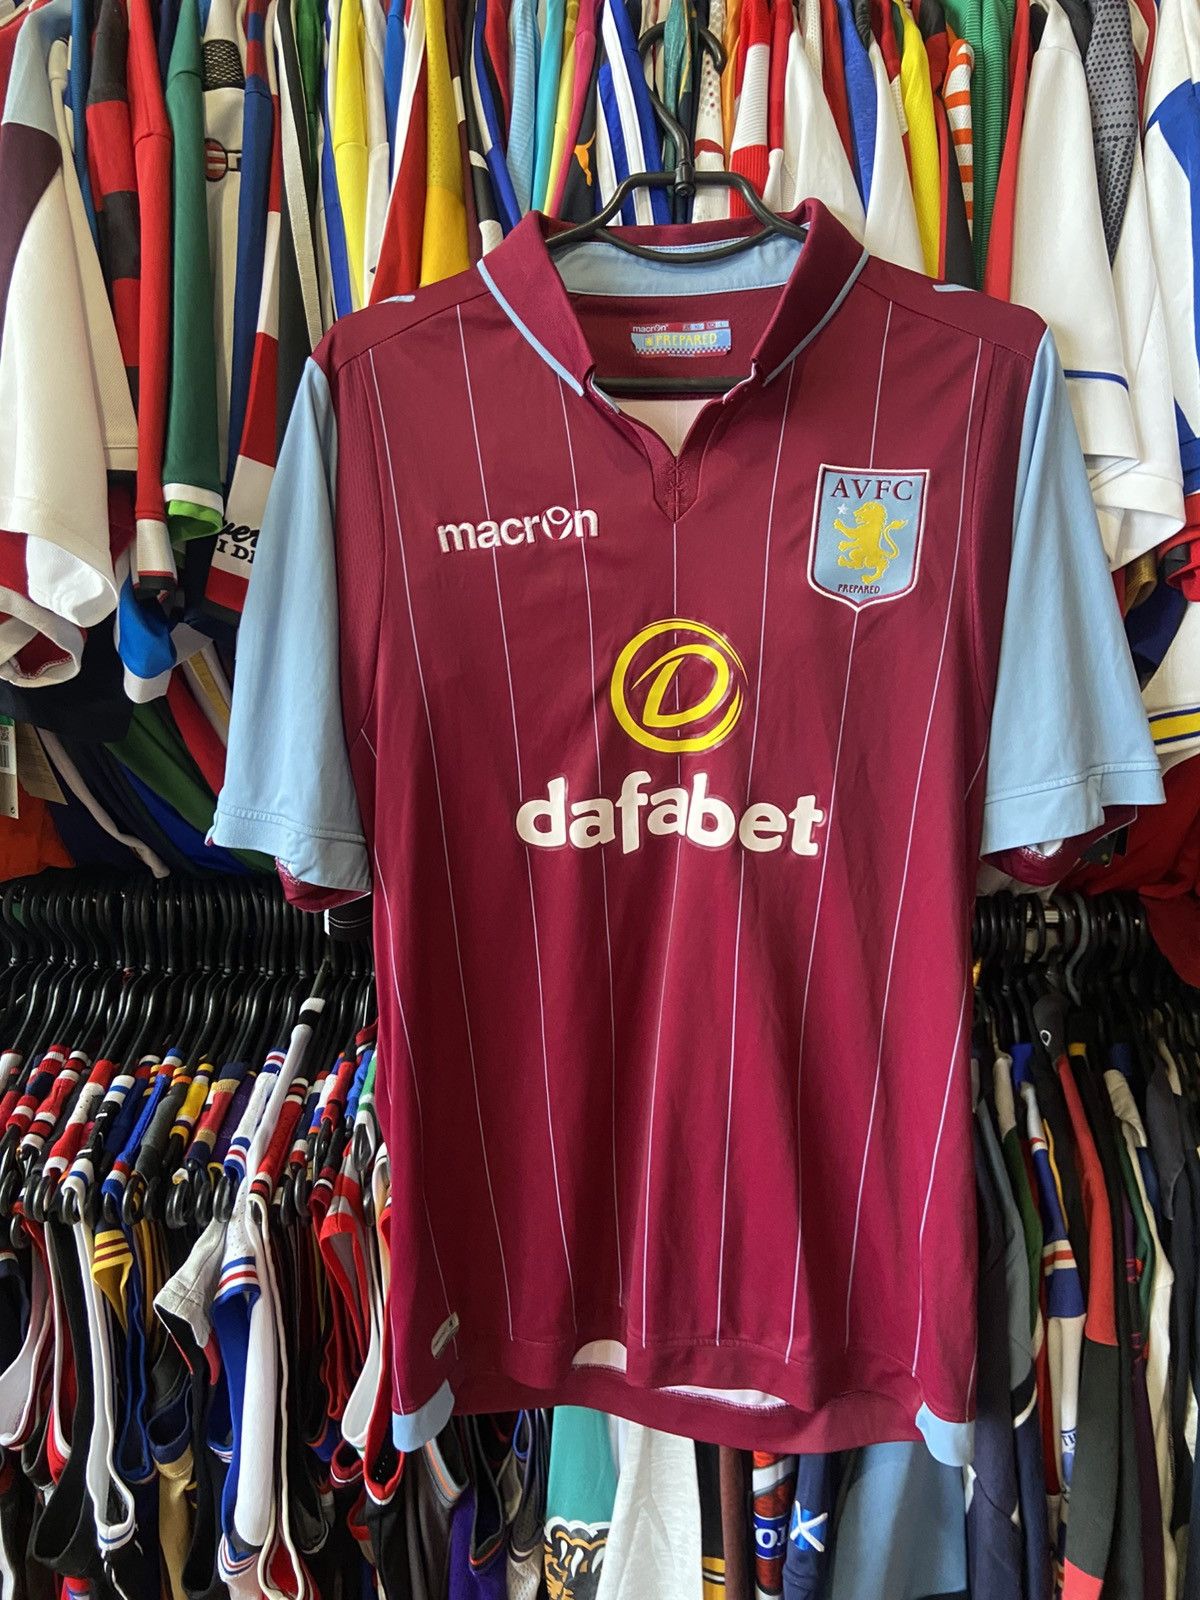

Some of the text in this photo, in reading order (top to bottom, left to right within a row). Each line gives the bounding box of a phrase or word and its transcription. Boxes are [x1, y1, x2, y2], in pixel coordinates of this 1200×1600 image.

[655, 332, 717, 347] PREPARED
[830, 477, 914, 501] AVFC
[437, 505, 599, 553] macron
[837, 583, 881, 595] PREPARED
[515, 770, 825, 857] dafabet
